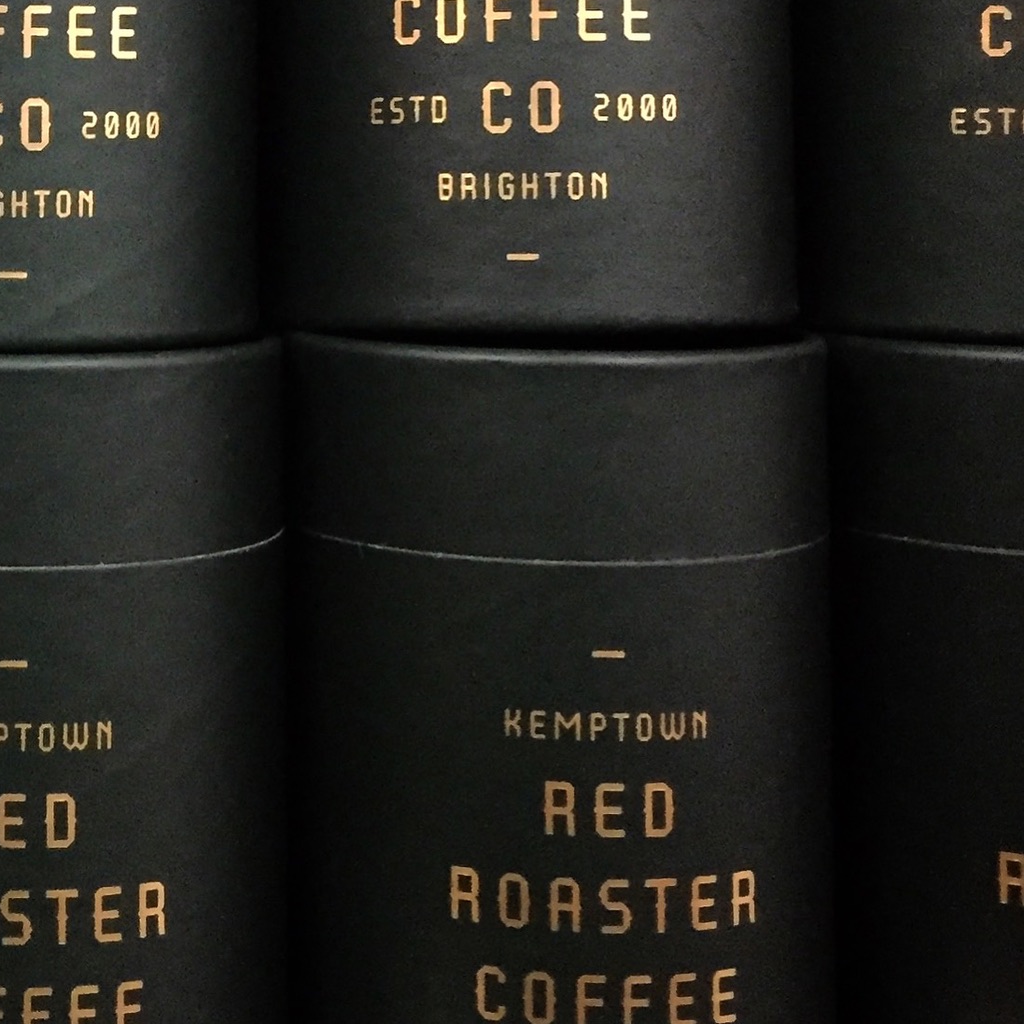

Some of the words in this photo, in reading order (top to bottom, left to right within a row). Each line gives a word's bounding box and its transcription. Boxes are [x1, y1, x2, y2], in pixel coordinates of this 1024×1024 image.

[82, 111, 159, 139] 2000
[370, 95, 447, 124] ESTD
[482, 81, 561, 134] CO
[593, 94, 677, 121] 2000
[950, 106, 1024, 135] EST
[438, 172, 607, 201] BRIGHTON
[504, 708, 708, 742] KEMPTOWN
[543, 780, 676, 838] RED
[449, 865, 757, 934] ROASTER
[474, 965, 737, 1024] COFFEE
